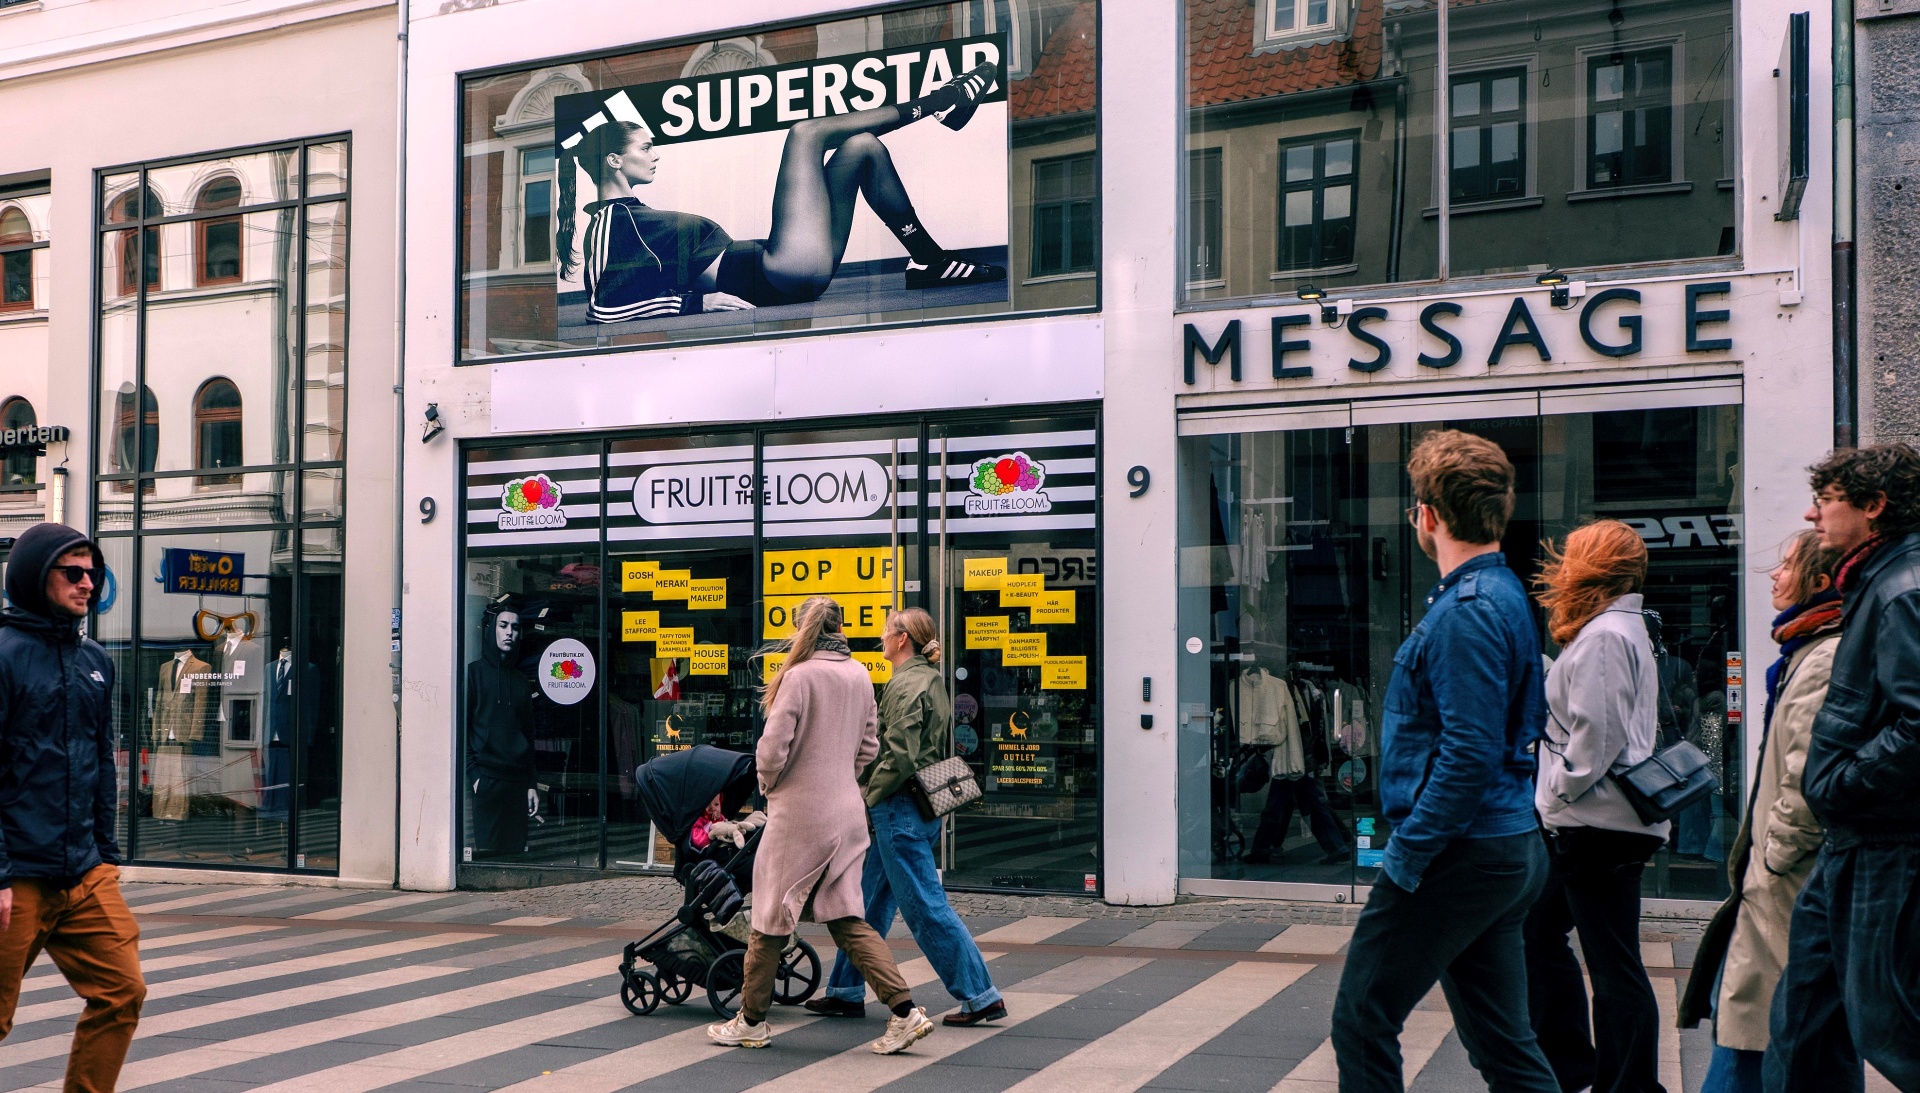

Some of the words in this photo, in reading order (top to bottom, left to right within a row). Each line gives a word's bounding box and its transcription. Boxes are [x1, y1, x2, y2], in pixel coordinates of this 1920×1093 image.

[1183, 281, 1733, 385] MESSAGE
[0, 424, 63, 446] erten
[1127, 465, 1150, 498] 9
[651, 475, 735, 509] FRUIT
[735, 490, 771, 506] THE
[776, 470, 868, 506] LOOM
[419, 497, 437, 524] 9
[968, 499, 1000, 511] FRUIT
[1011, 498, 1045, 509] LOOM
[501, 515, 526, 527] FRUIT
[535, 514, 562, 525] LOOM
[628, 571, 654, 580] GOSH
[770, 560, 832, 582] POP
[857, 556, 893, 580] UP
[968, 569, 1003, 577] MAKEUP
[655, 580, 689, 588] MERAKI
[690, 594, 724, 602] MAKEUP
[768, 605, 893, 628] OLET
[694, 649, 725, 658] HOUSE
[692, 662, 726, 670] DOCTOR
[224, 672, 240, 680] SUIT
[1003, 753, 1036, 761] OUTLET
